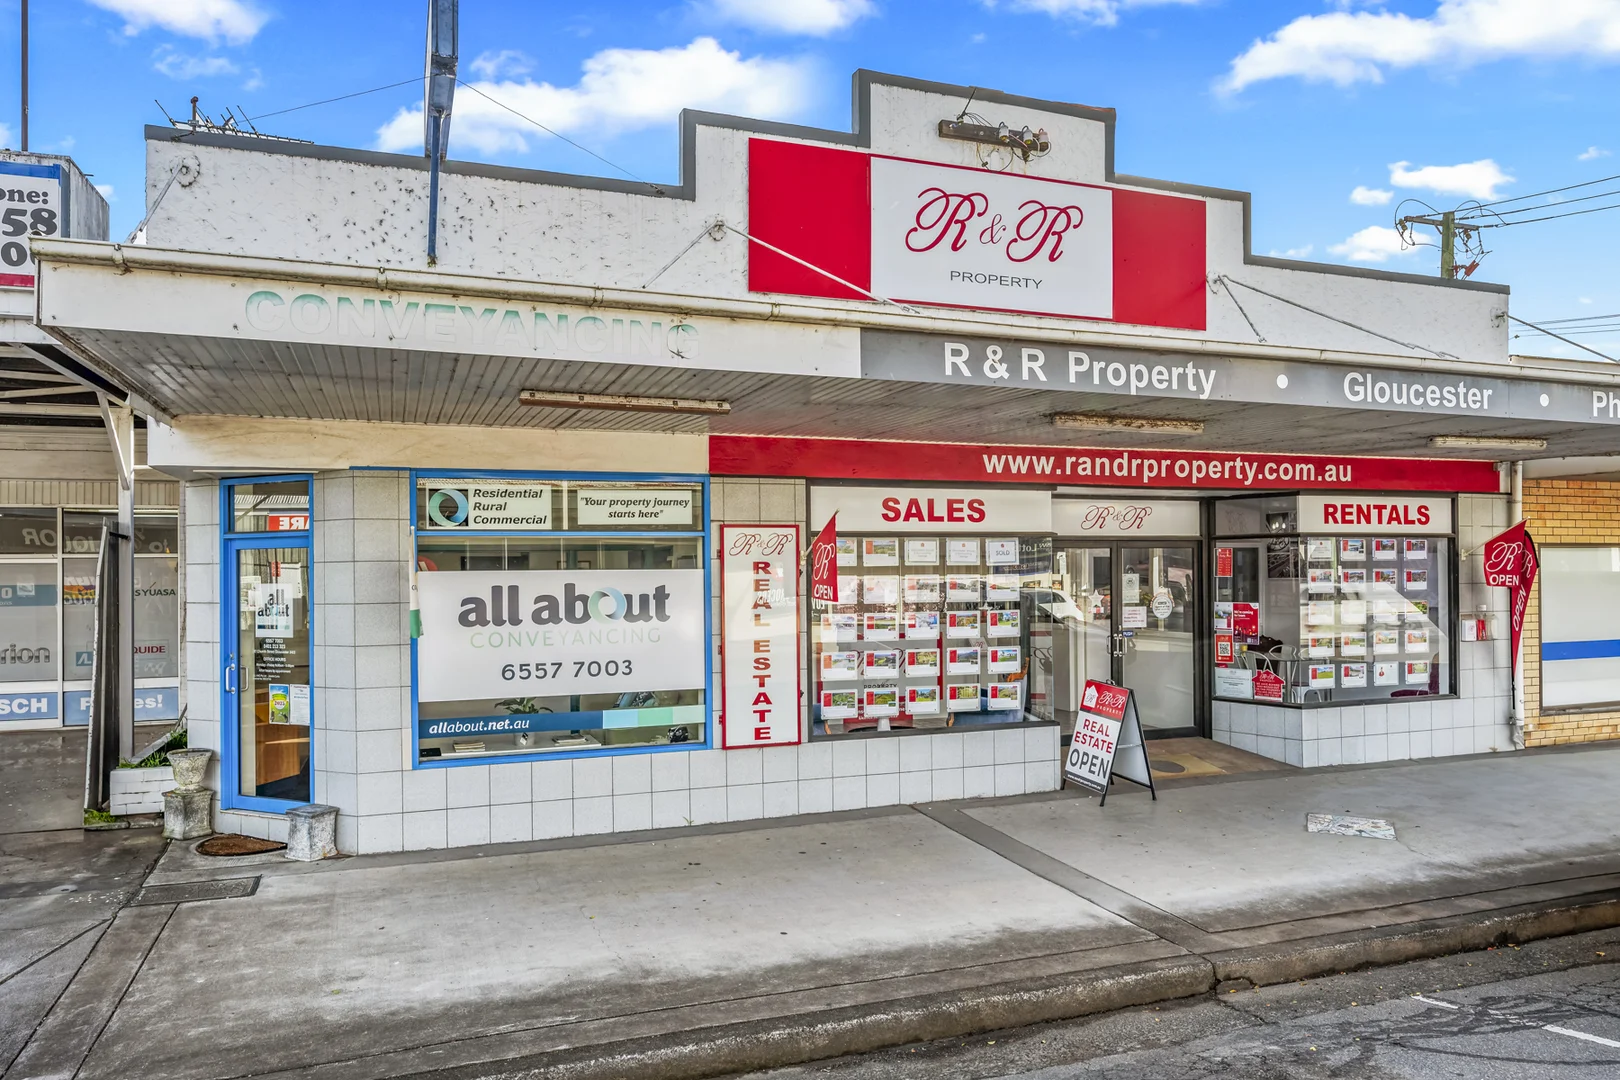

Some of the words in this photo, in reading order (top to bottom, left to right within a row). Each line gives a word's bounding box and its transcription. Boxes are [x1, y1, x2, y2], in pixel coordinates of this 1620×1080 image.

[2, 207, 58, 238] 58
[905, 187, 989, 253] R
[980, 213, 1007, 245] &
[1006, 200, 1084, 262] R
[0, 240, 37, 267] 0
[949, 270, 1043, 290] PROPERTY
[245, 290, 701, 360] CONVEYANCING
[944, 341, 973, 378] R
[982, 344, 1011, 380] &
[1020, 347, 1048, 381] R
[1067, 350, 1217, 400] Property
[1343, 371, 1493, 410] Gloucester
[982, 452, 1353, 486] www.randrproperty.com.au
[473, 488, 543, 499] Residential
[580, 497, 609, 507] "Your
[609, 497, 651, 509] property
[651, 497, 690, 509] journey
[473, 501, 507, 511] Rural
[608, 509, 636, 519] starts
[637, 509, 664, 519] here"
[881, 497, 986, 523] SALES
[1323, 503, 1431, 526] RENTALS
[473, 514, 548, 525] Commercial
[1489, 574, 1519, 586] OPEN
[140, 587, 176, 597] YUASA
[751, 561, 772, 627] REAL
[814, 584, 833, 600] OPEN
[458, 584, 523, 628] all
[530, 582, 672, 626] about
[1512, 584, 1527, 632] OPEN
[470, 627, 661, 649] CONVEYANCING
[501, 662, 563, 681] 6557
[573, 659, 633, 678] 7003
[751, 639, 773, 741] ESTATE
[428, 718, 530, 735] allabout.net.au
[1083, 719, 1110, 738] REAL
[1074, 731, 1114, 754] ESTATE
[1069, 748, 1110, 779] OPEN
